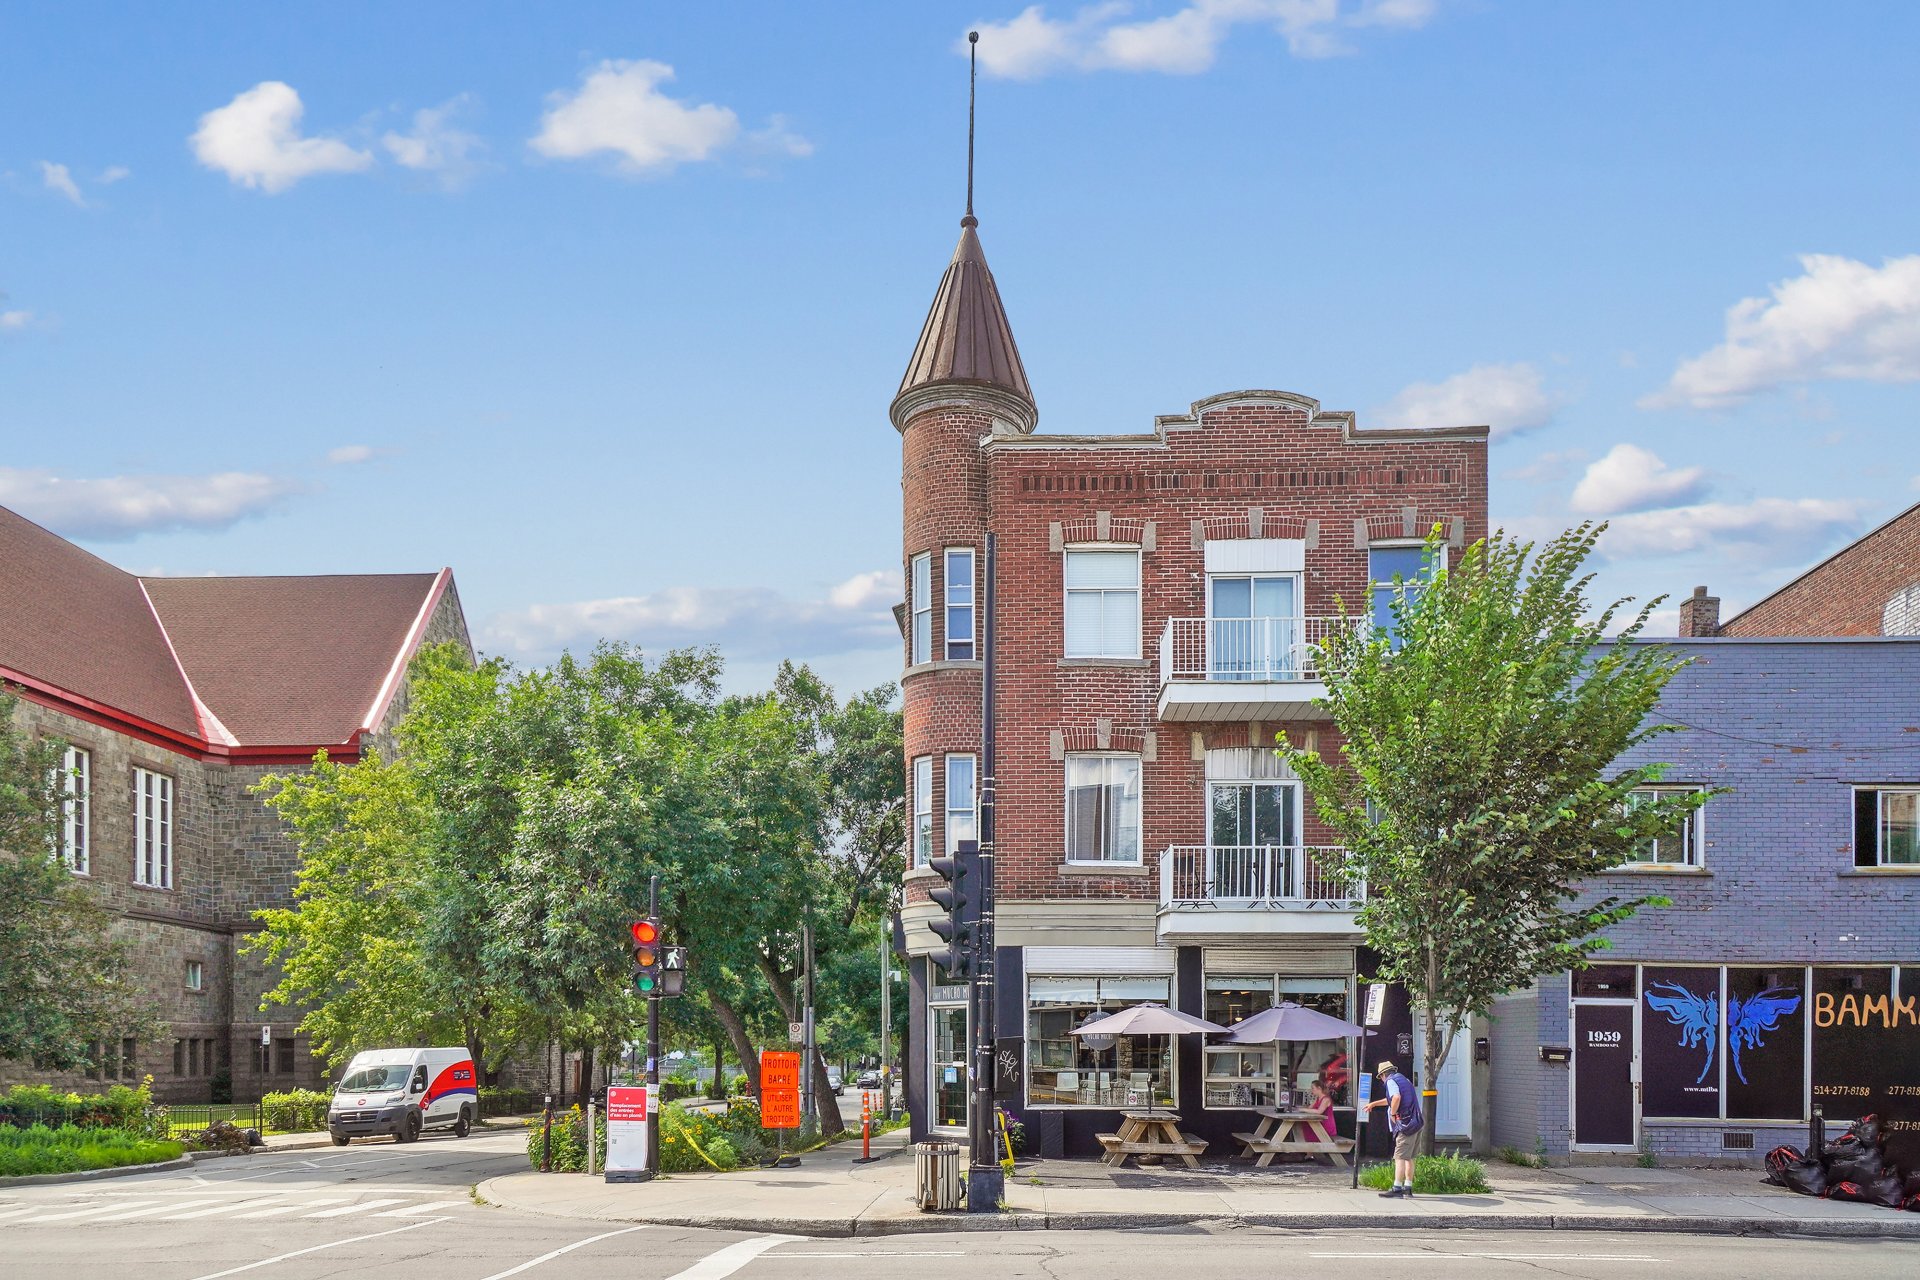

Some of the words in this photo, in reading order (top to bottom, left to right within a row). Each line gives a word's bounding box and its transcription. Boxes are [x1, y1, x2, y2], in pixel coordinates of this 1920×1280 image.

[1587, 1030, 1621, 1042] 1959
[764, 1058, 797, 1069] TROTTOIR
[1814, 1085, 1871, 1096] 514-277-8188
[767, 1094, 793, 1102] UTILISER
[766, 1115, 794, 1123] TROTTOIR
